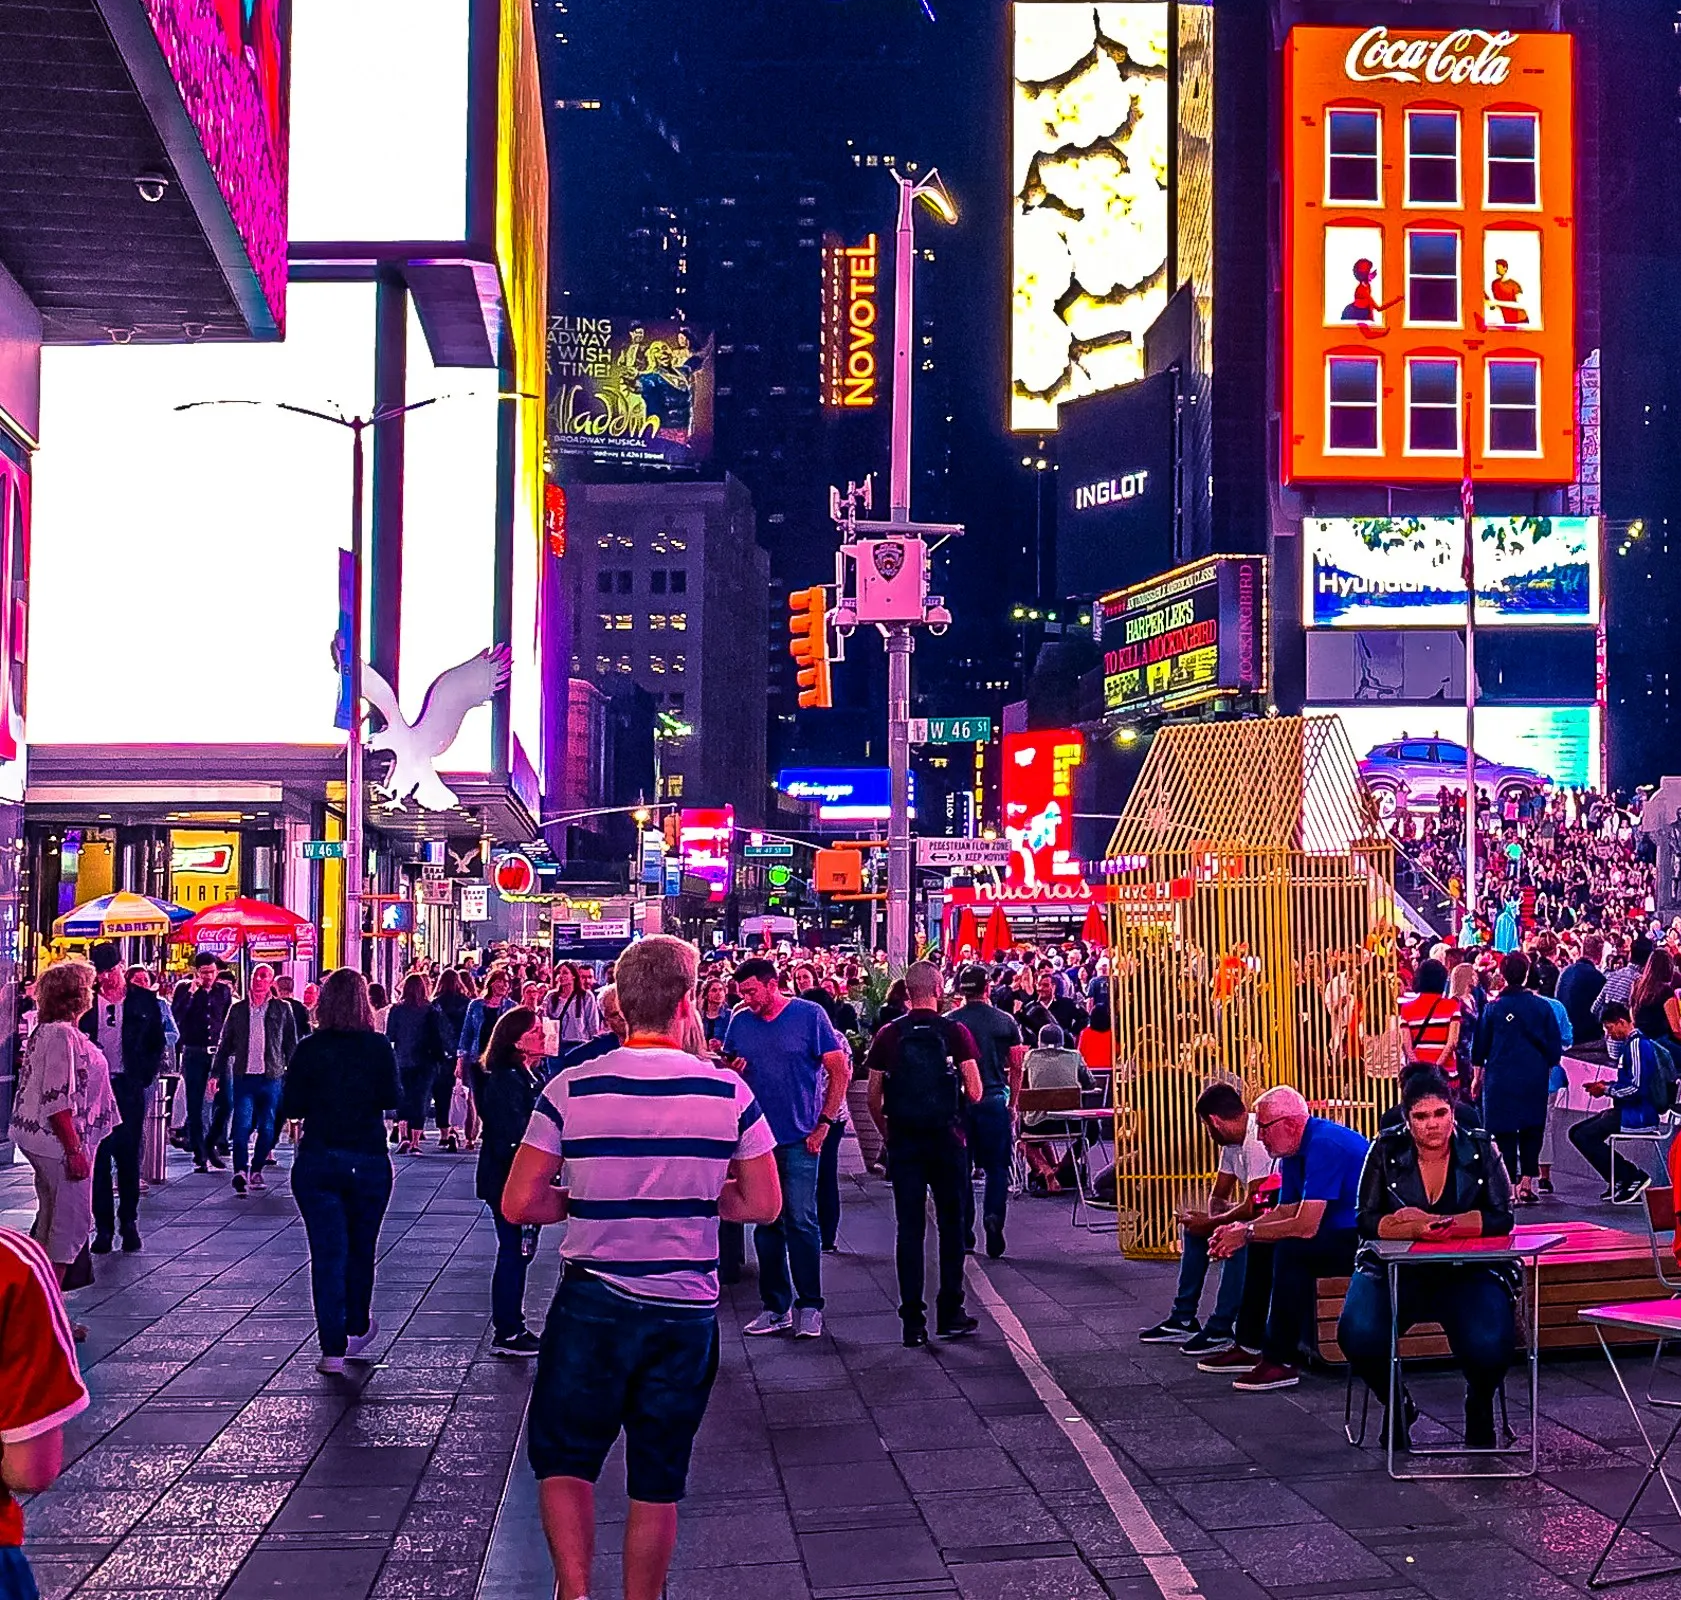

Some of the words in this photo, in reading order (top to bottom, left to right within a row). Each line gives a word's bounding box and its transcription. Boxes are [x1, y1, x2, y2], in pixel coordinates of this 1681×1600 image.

[547, 316, 612, 334] ZLING
[843, 233, 878, 406] NOVOTEL
[558, 346, 612, 363] WISH
[553, 435, 606, 445] BROADWAY
[607, 437, 648, 448] MUSICAL
[1075, 470, 1149, 510] INGLOT
[1125, 608, 1165, 644] HARPER
[1104, 650, 1118, 675] TO
[1118, 644, 1142, 672] KILL
[1148, 619, 1217, 664] MOCKINGBIRD
[930, 725, 945, 739] W
[951, 721, 971, 739] 46
[977, 719, 988, 732] St
[304, 843, 315, 857] W
[318, 841, 333, 857] 46
[929, 841, 971, 851] PEDESTRIAN
[972, 841, 990, 851] FLOW
[991, 840, 1010, 851] ZONE
[965, 853, 982, 862] KEEP
[107, 921, 166, 933] SABRETT
